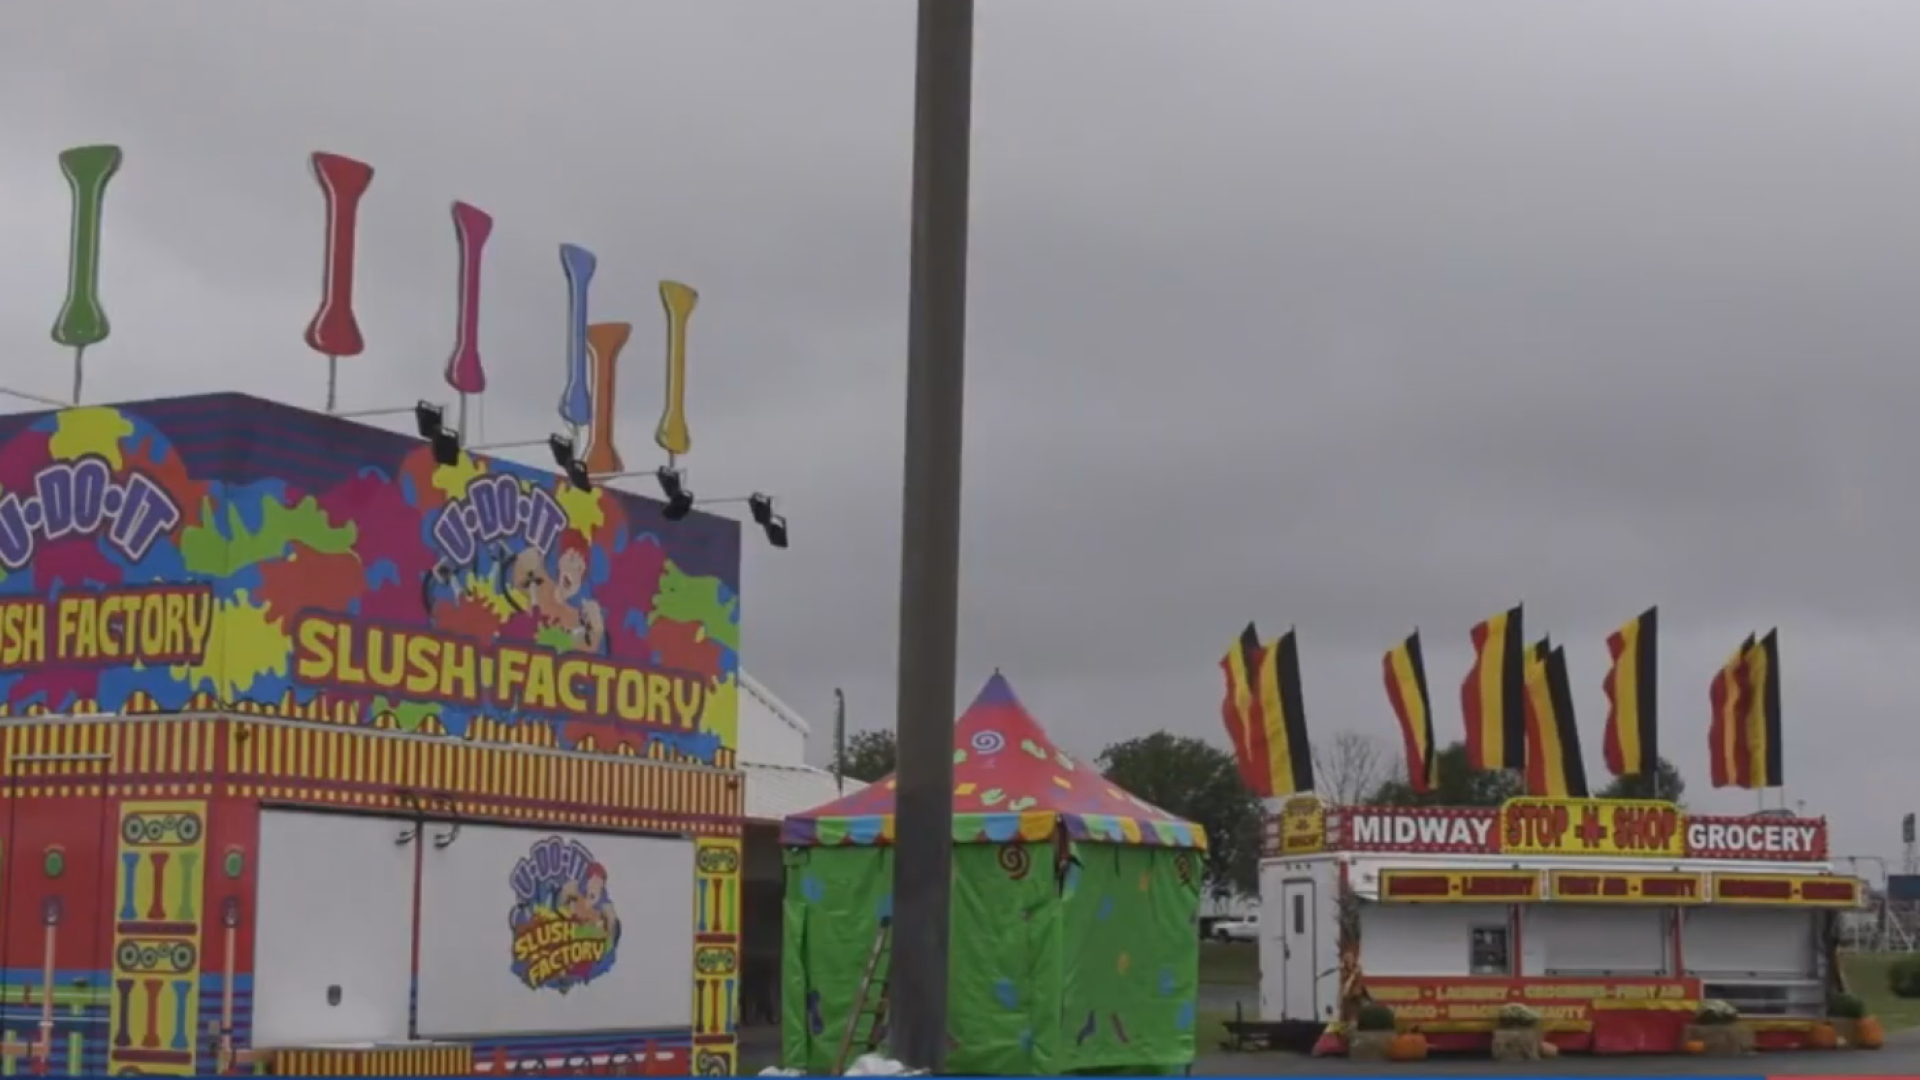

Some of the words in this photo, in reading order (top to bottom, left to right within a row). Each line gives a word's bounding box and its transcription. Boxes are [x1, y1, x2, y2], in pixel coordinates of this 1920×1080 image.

[58, 593, 210, 657] FACTORY
[299, 618, 477, 699] SLUSH
[499, 647, 701, 730] FACTORY
[1353, 816, 1492, 844] MIDWAY
[1507, 804, 1568, 848] STOP
[1613, 806, 1676, 850] SHOP
[1688, 824, 1815, 852] GROCERY
[515, 922, 576, 961] SLUSH
[528, 940, 604, 987] FACTORY
